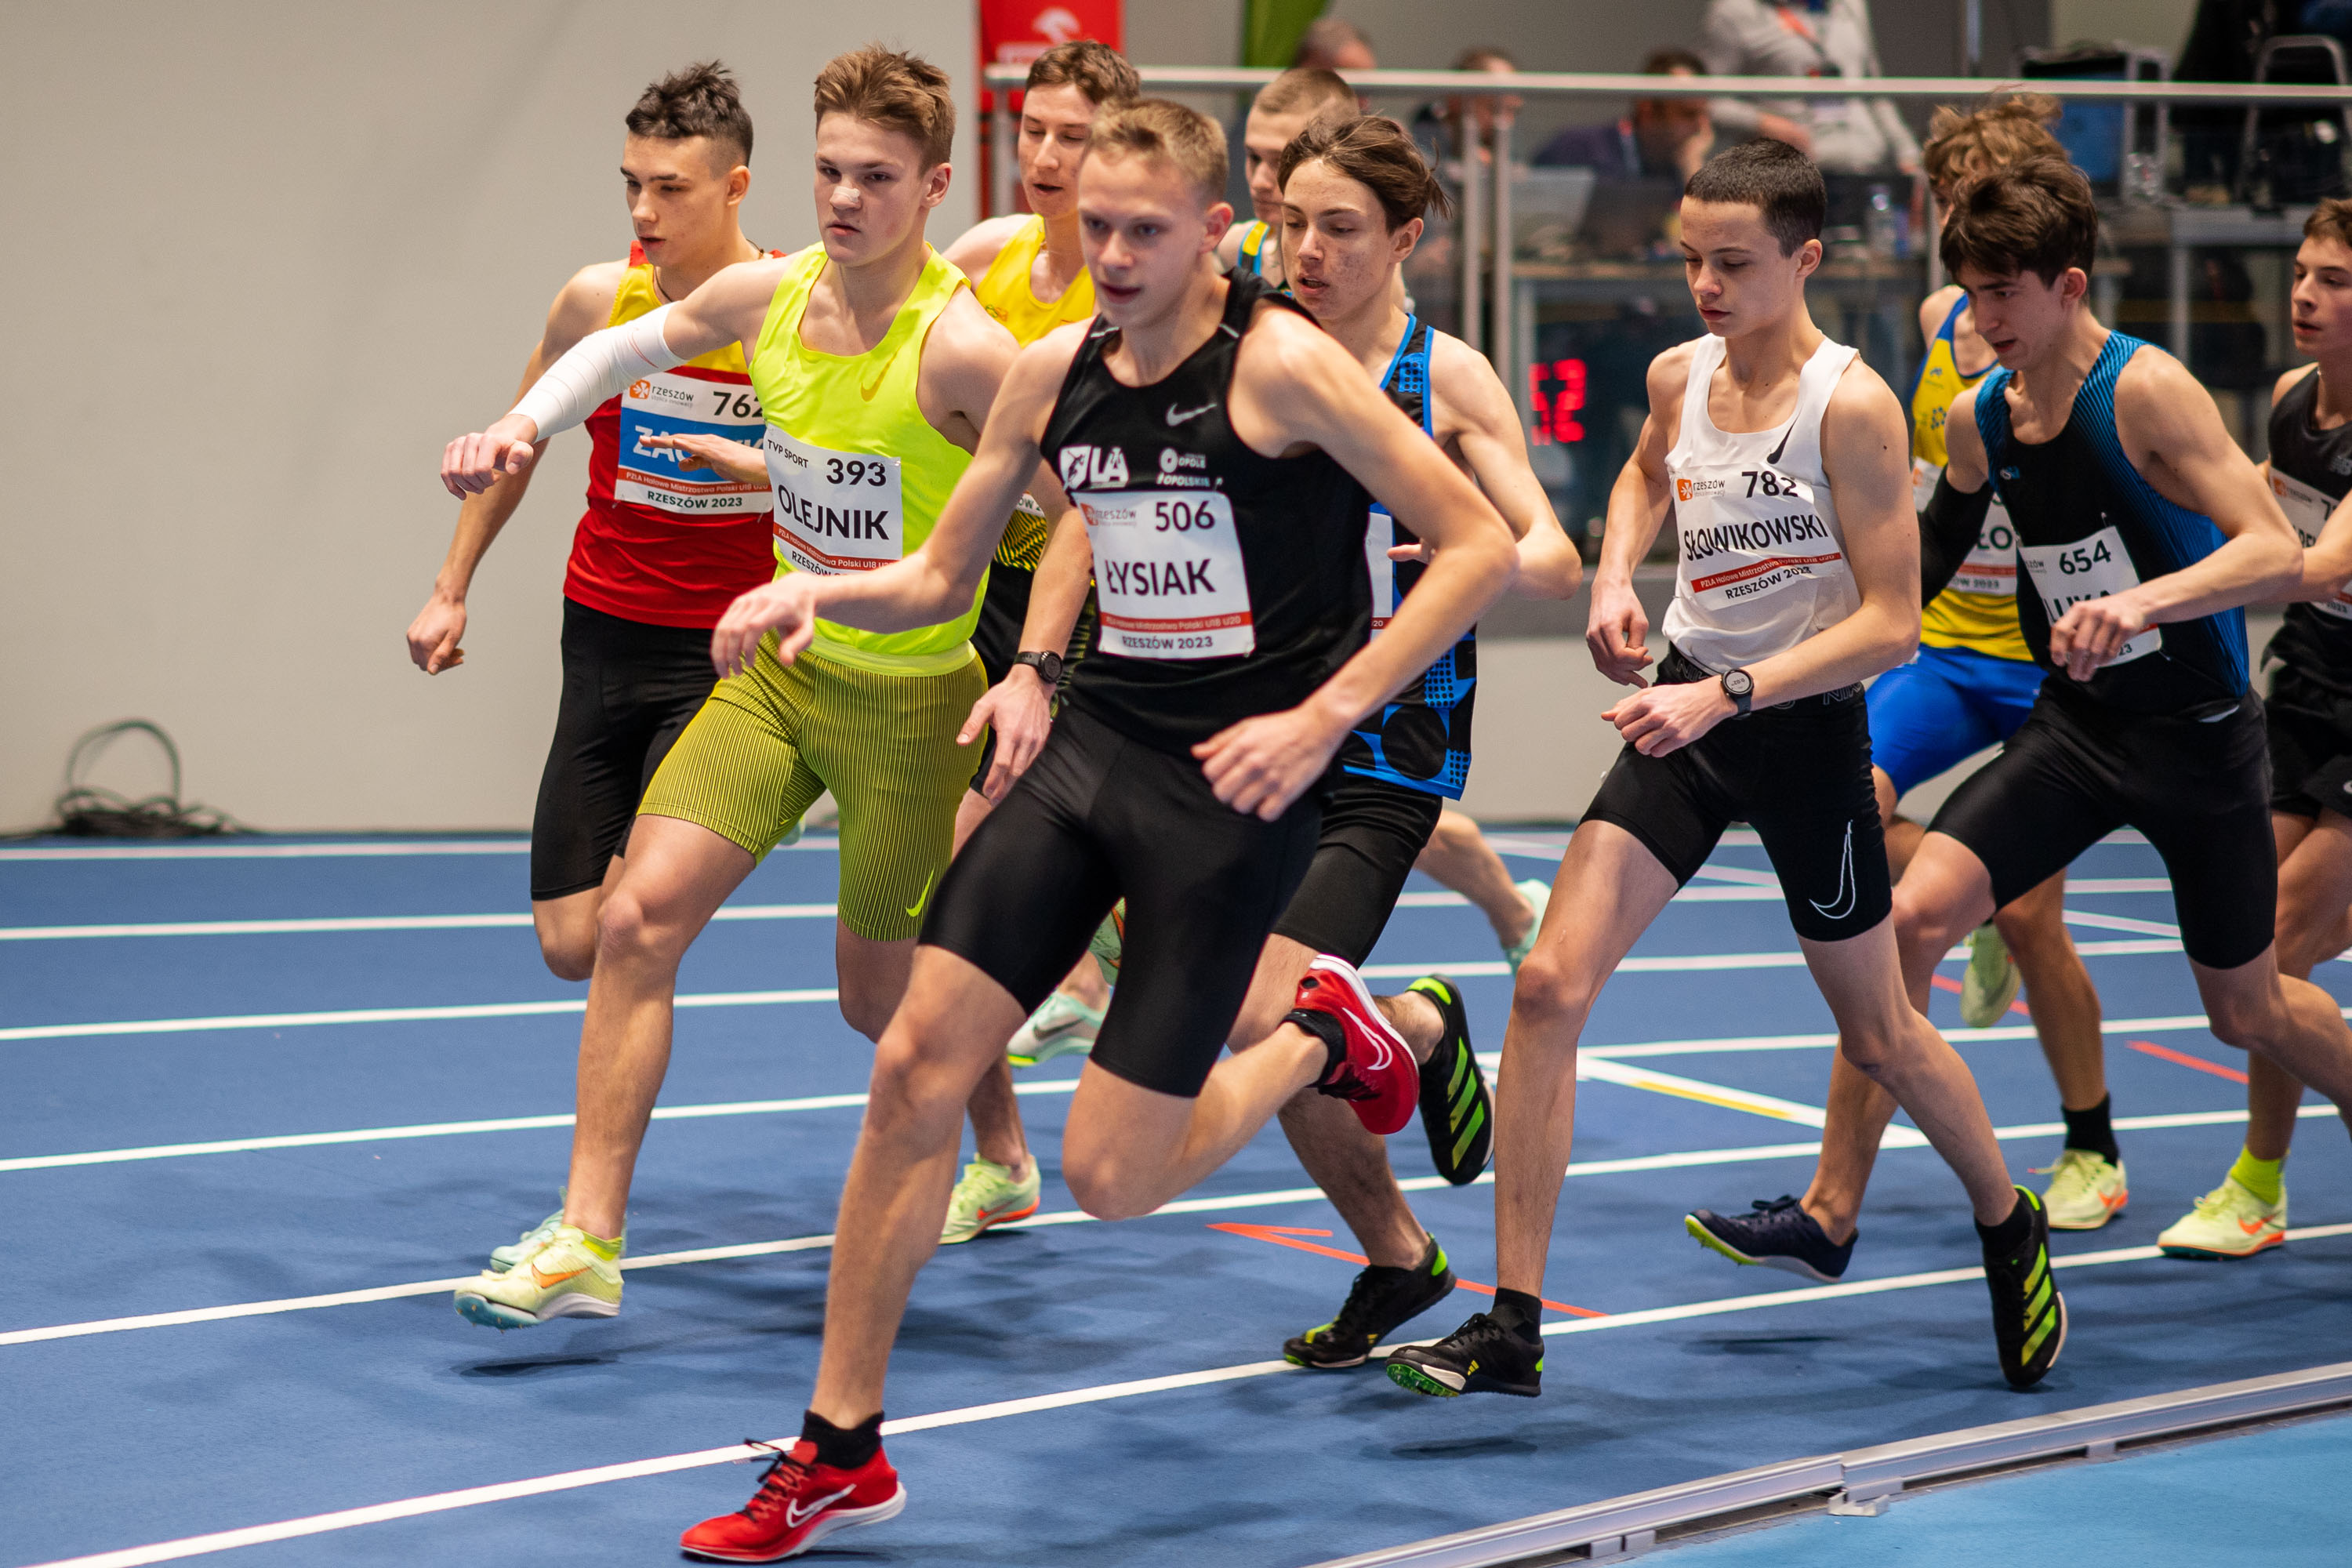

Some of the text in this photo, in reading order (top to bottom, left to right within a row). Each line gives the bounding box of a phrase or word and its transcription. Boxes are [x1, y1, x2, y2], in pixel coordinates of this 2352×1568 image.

[652, 385, 695, 401] rzeszów
[768, 439, 783, 454] TVP
[784, 448, 808, 468] SPORT
[1178, 457, 1206, 469] OPOLE
[626, 472, 642, 481] PZLA
[644, 477, 670, 488] Halowe
[670, 483, 715, 493] Mistrzostwa
[716, 484, 738, 492] Polski
[826, 458, 887, 487] 393
[1693, 479, 1726, 491] rzeszów
[1741, 470, 1798, 499] 782
[648, 491, 742, 508] RZESZÓW 2023
[778, 484, 889, 540] OLEJNIK
[1155, 500, 1216, 532] 506
[1684, 514, 1828, 561] SŁOWIKOWSKI
[792, 550, 831, 575] RZESZÓW
[837, 559, 862, 568] Polski
[862, 560, 877, 568] U18
[2060, 539, 2111, 575] 654
[1105, 558, 1217, 596] ŁYSIAK
[1700, 579, 1716, 588] PZLA
[1716, 573, 1739, 584] Halowe
[1739, 560, 1779, 578] Mistrzostwa
[1726, 566, 1812, 599] RZESZÓW 2023
[1222, 615, 1241, 626] U20
[1122, 636, 1214, 649] RZESZÓW 2023
